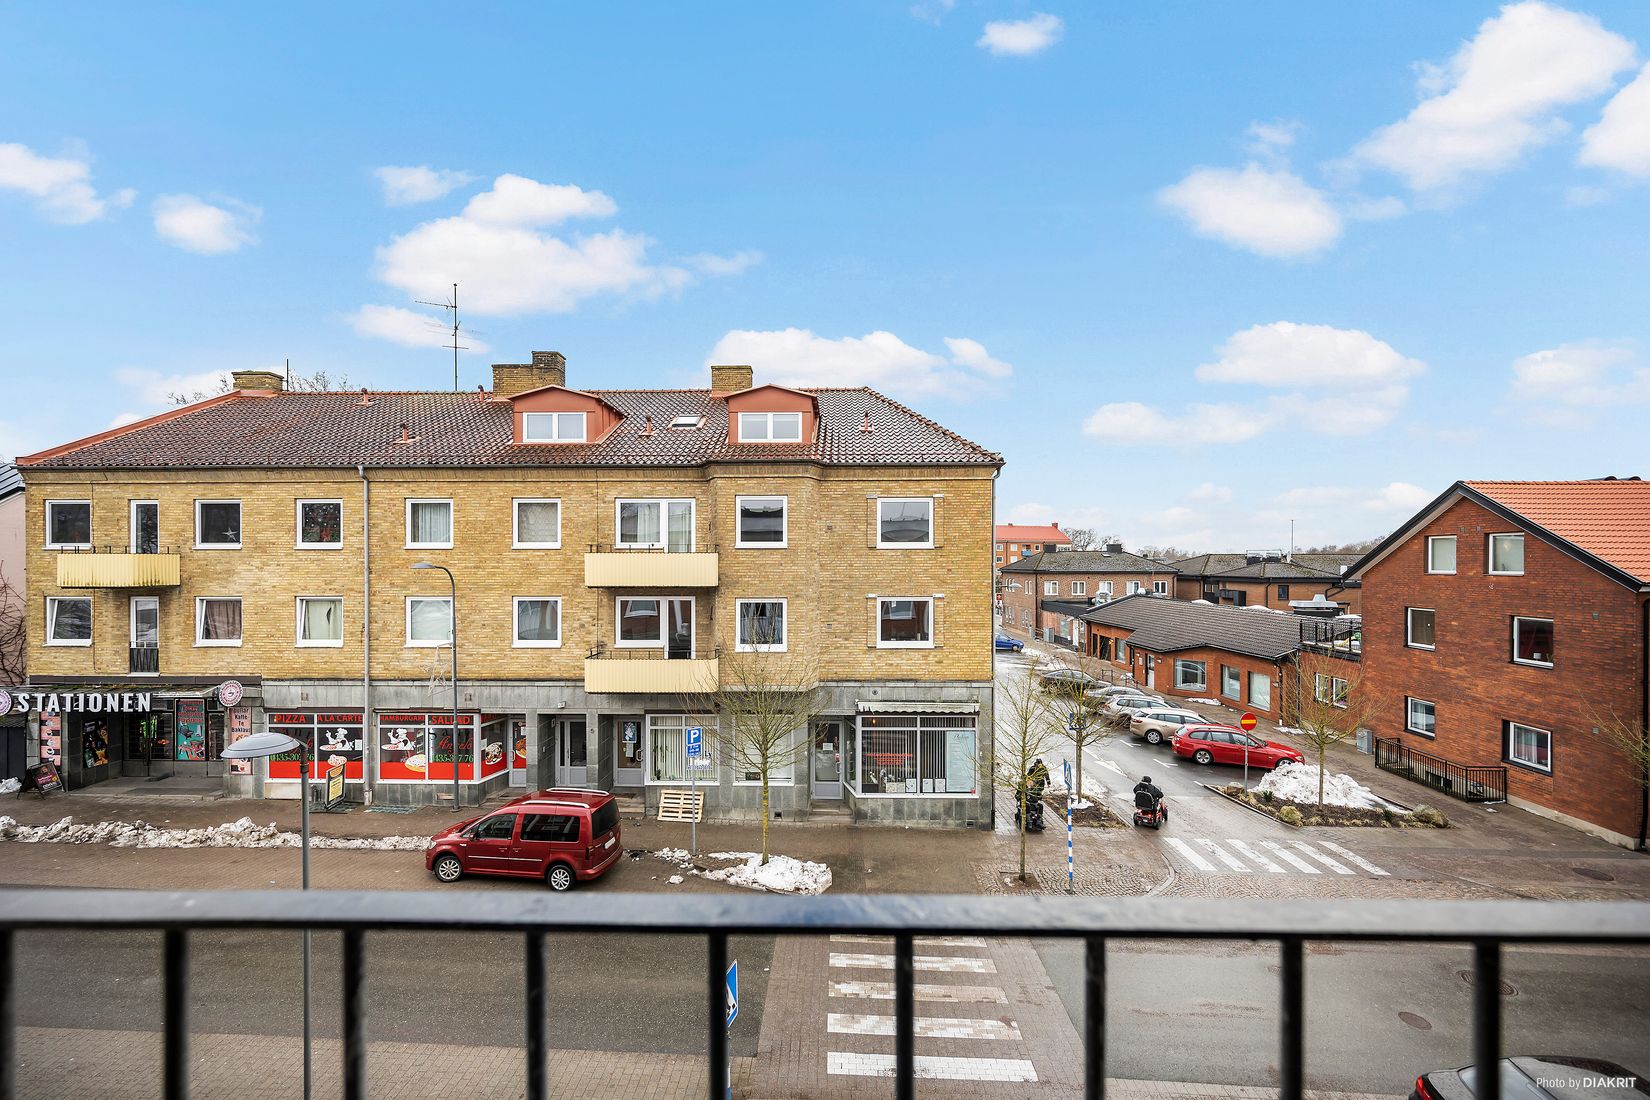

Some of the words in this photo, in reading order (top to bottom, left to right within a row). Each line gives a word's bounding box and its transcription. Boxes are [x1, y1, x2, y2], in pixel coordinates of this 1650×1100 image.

[18, 693, 151, 712] STATIONEN
[275, 714, 307, 723] PIZZA
[317, 714, 323, 722] A
[325, 714, 334, 722] LA
[338, 714, 363, 722] CARTE
[690, 730, 700, 743] P
